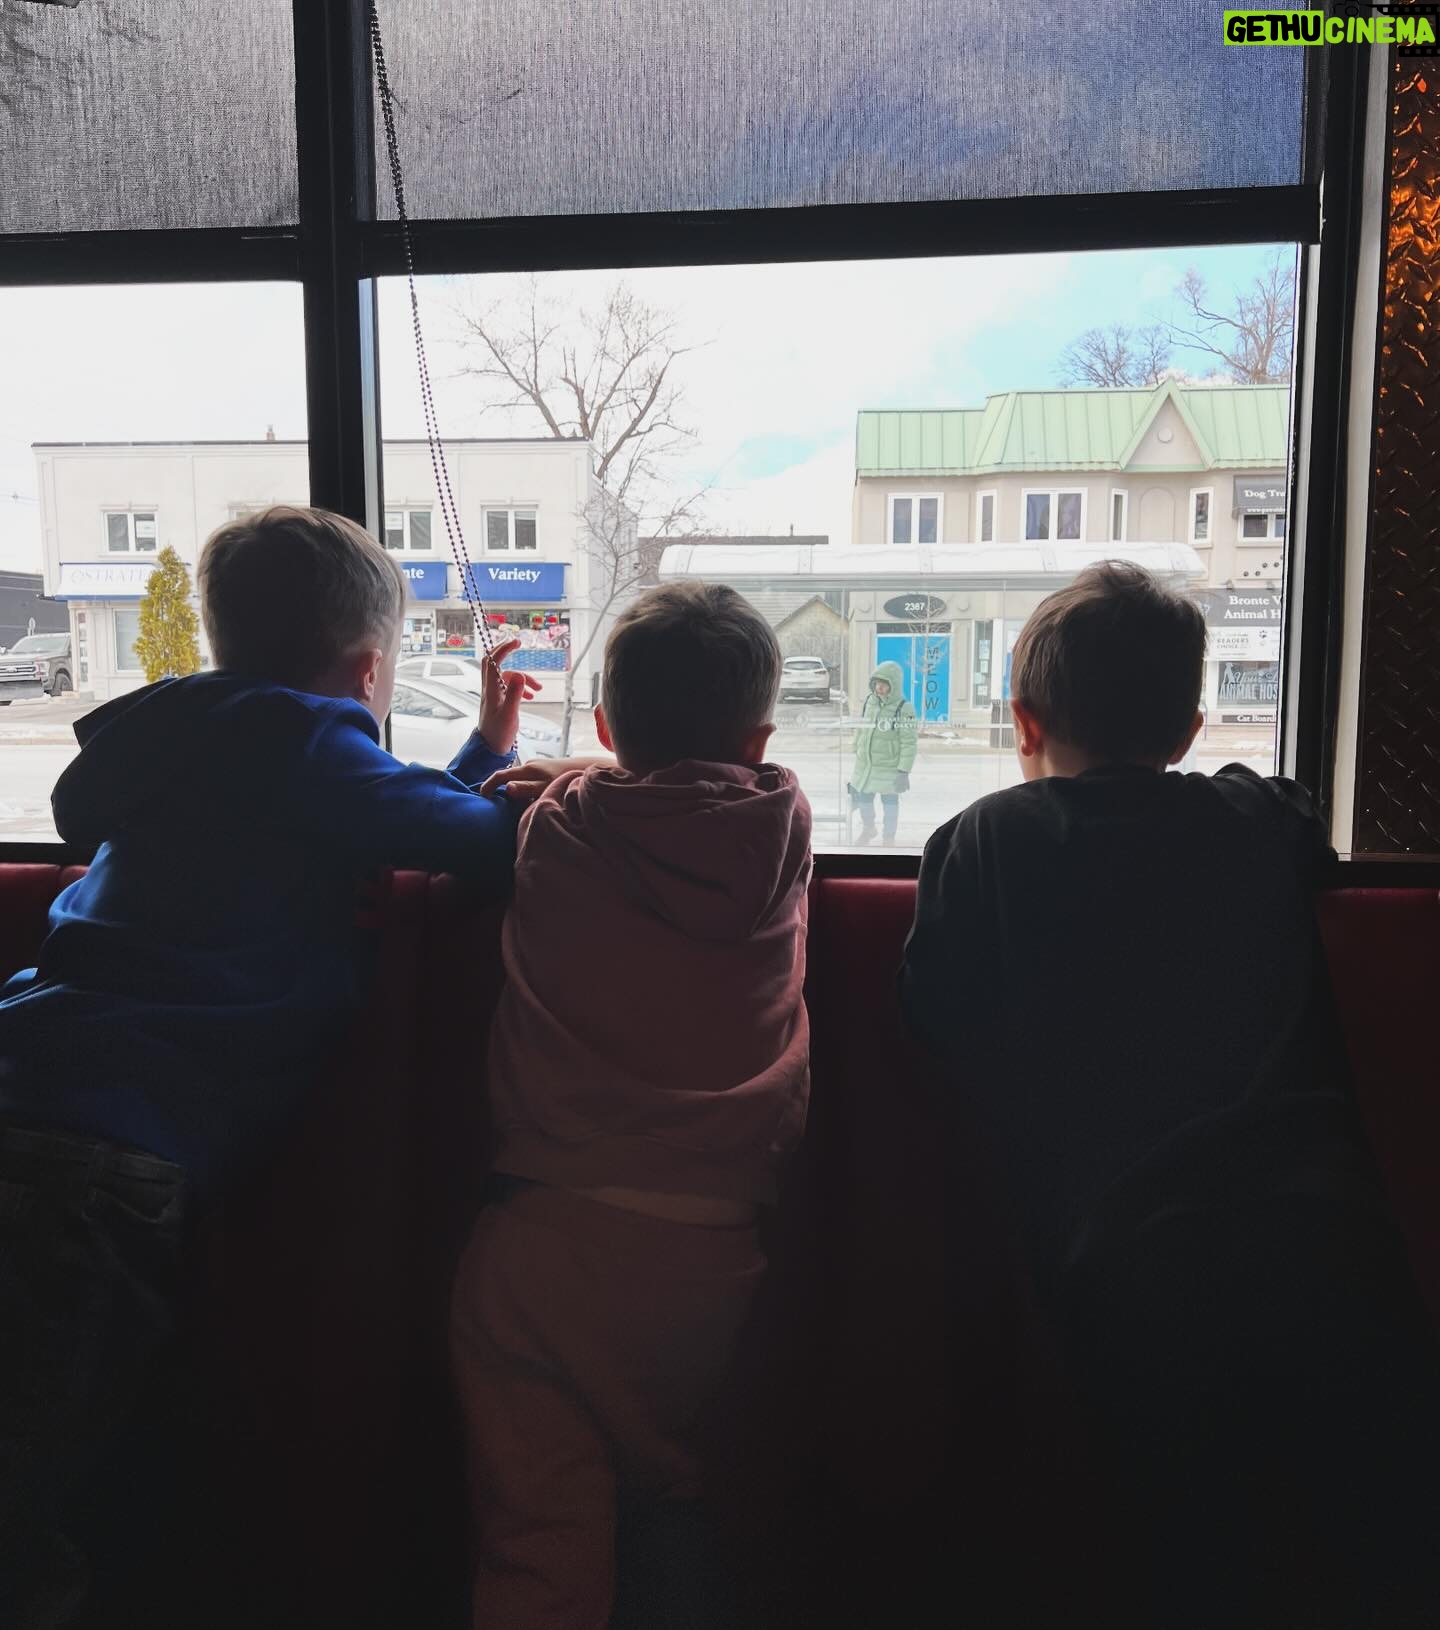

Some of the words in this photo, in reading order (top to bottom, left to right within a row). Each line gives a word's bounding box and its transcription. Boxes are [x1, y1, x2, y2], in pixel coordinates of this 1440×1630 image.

[1244, 489, 1266, 499] Dog
[488, 567, 541, 583] Variety
[1229, 595, 1270, 606] Bronte
[904, 602, 925, 611] 2387
[1224, 609, 1268, 619] Animal
[925, 647, 939, 710] MEOW
